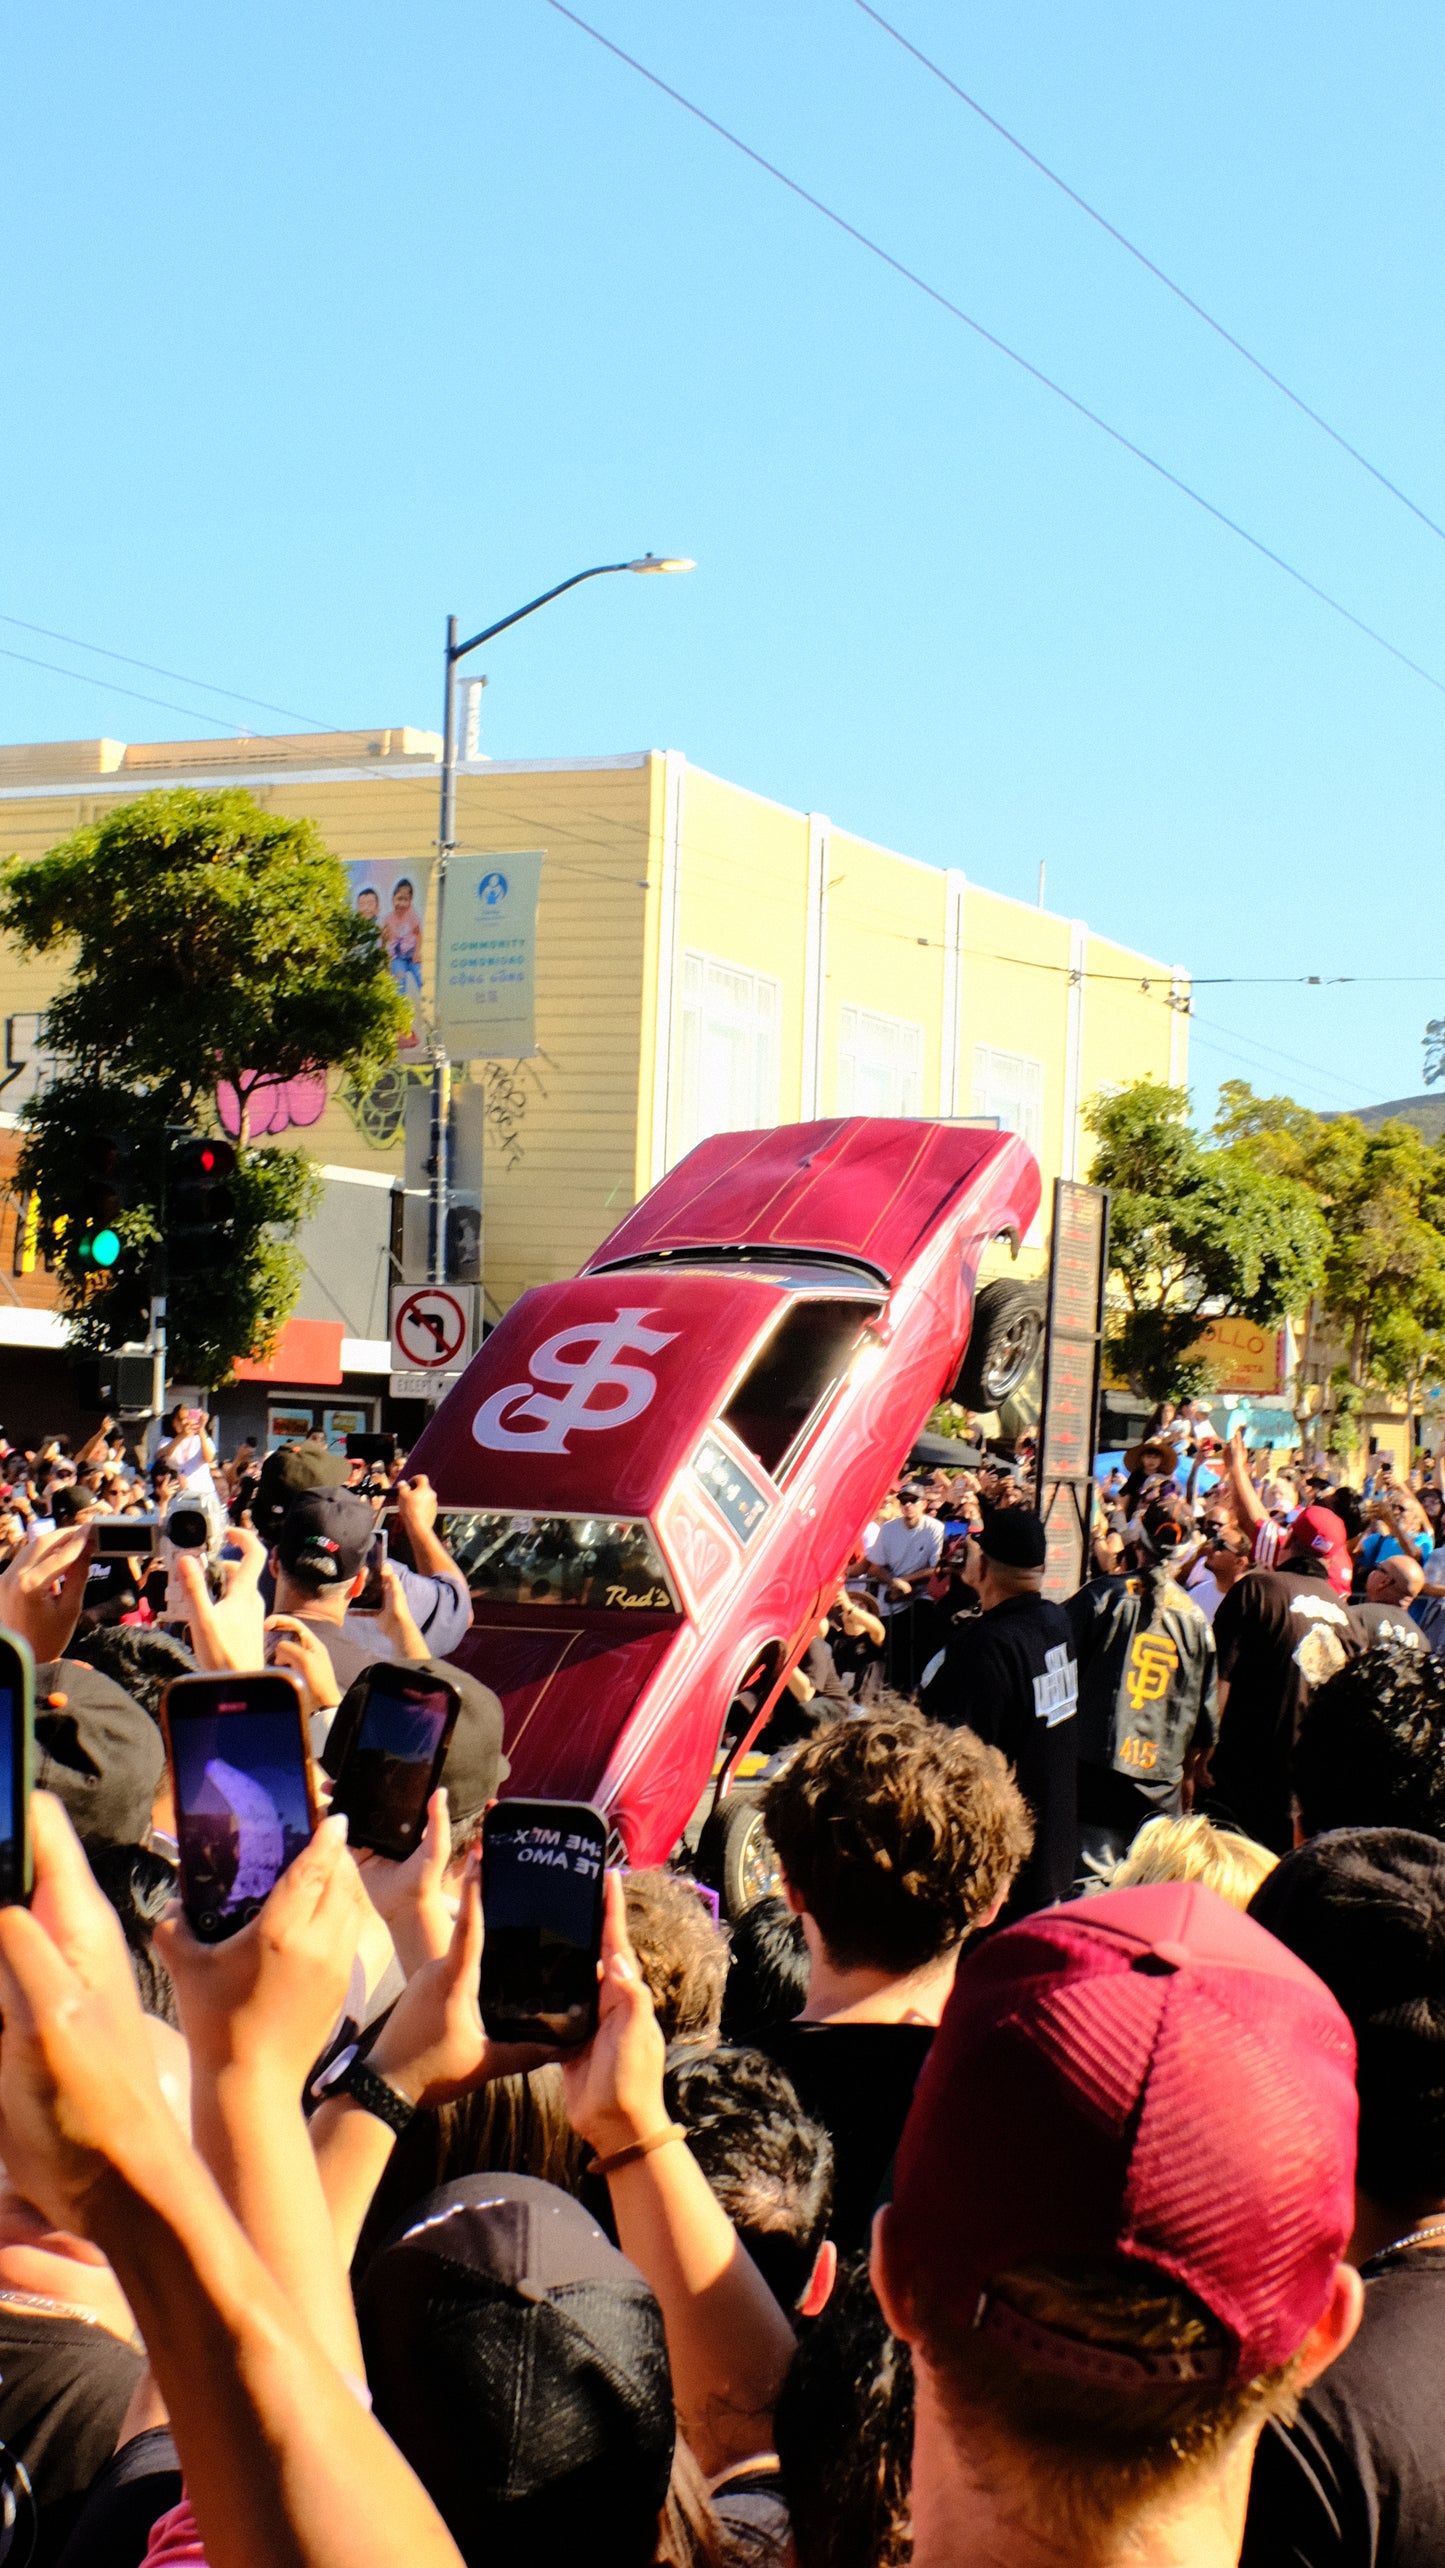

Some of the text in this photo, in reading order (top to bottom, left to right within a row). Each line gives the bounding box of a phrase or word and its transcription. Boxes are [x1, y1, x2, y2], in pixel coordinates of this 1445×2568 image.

[450, 939, 525, 952] COMMUNITY
[1200, 1325, 1264, 1354] OLLO
[1126, 1632, 1179, 1710] SF
[1119, 1736, 1158, 1769] 415
